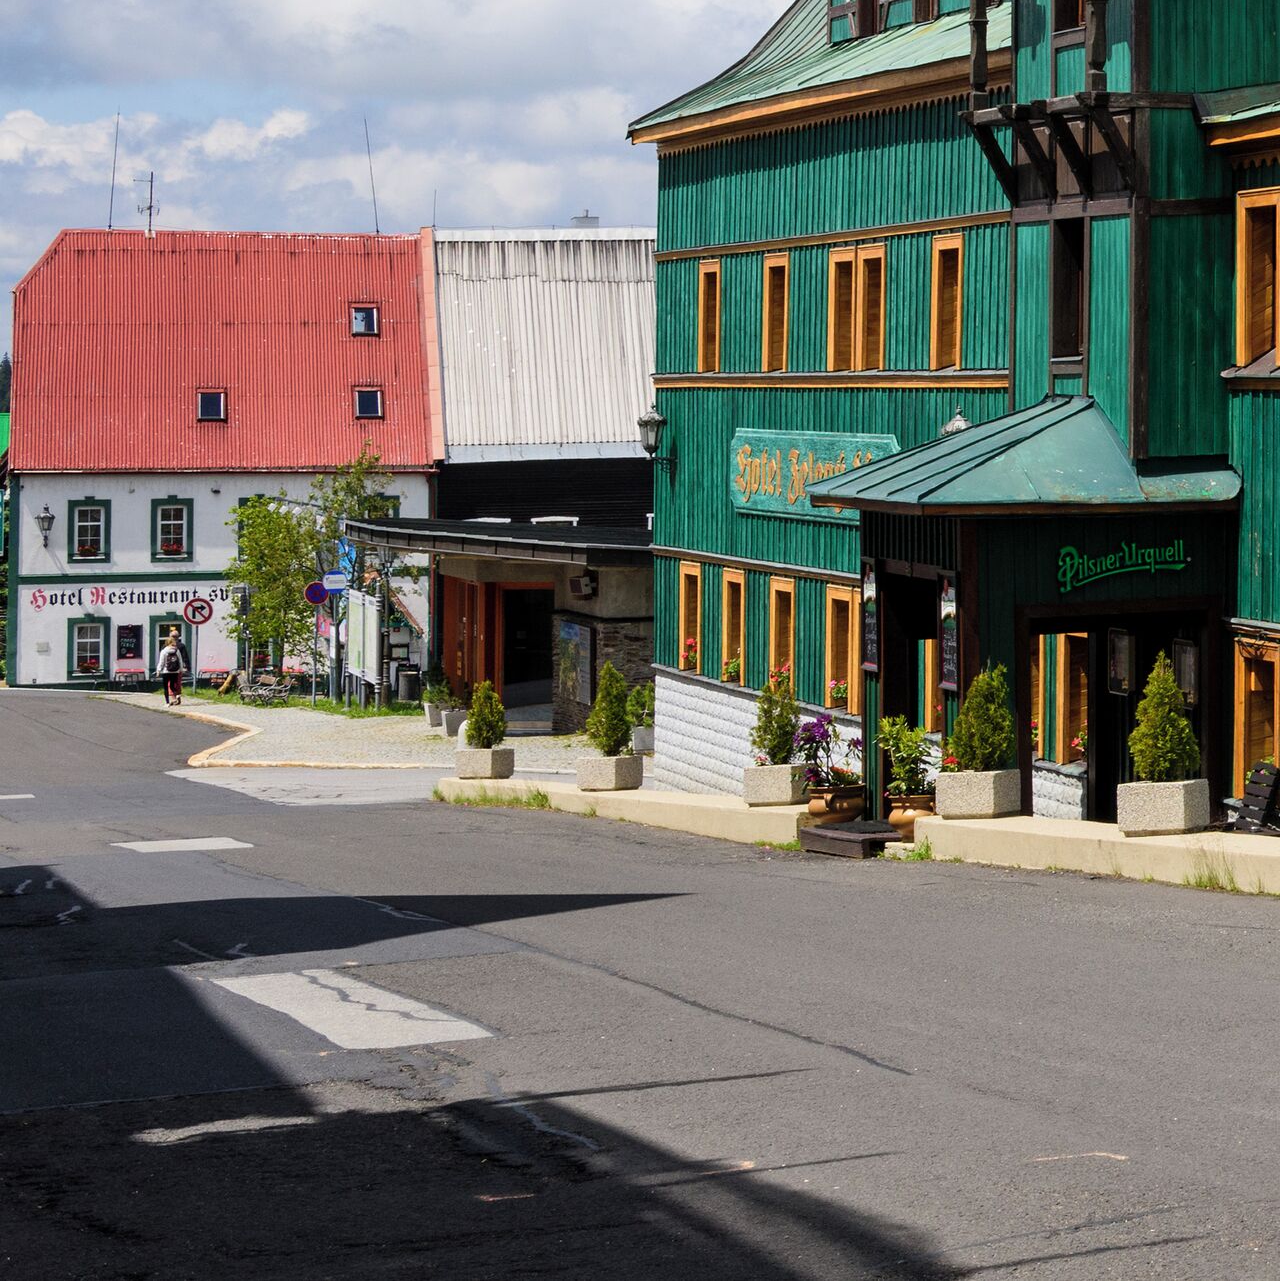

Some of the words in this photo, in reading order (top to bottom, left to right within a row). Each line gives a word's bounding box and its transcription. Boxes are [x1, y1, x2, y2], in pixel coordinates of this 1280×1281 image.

[735, 444, 782, 503] Hotel
[1057, 545, 1123, 593] Pilsner
[1121, 540, 1184, 573] Urquell
[30, 588, 83, 612] Hotel
[90, 585, 200, 607] Restaurant
